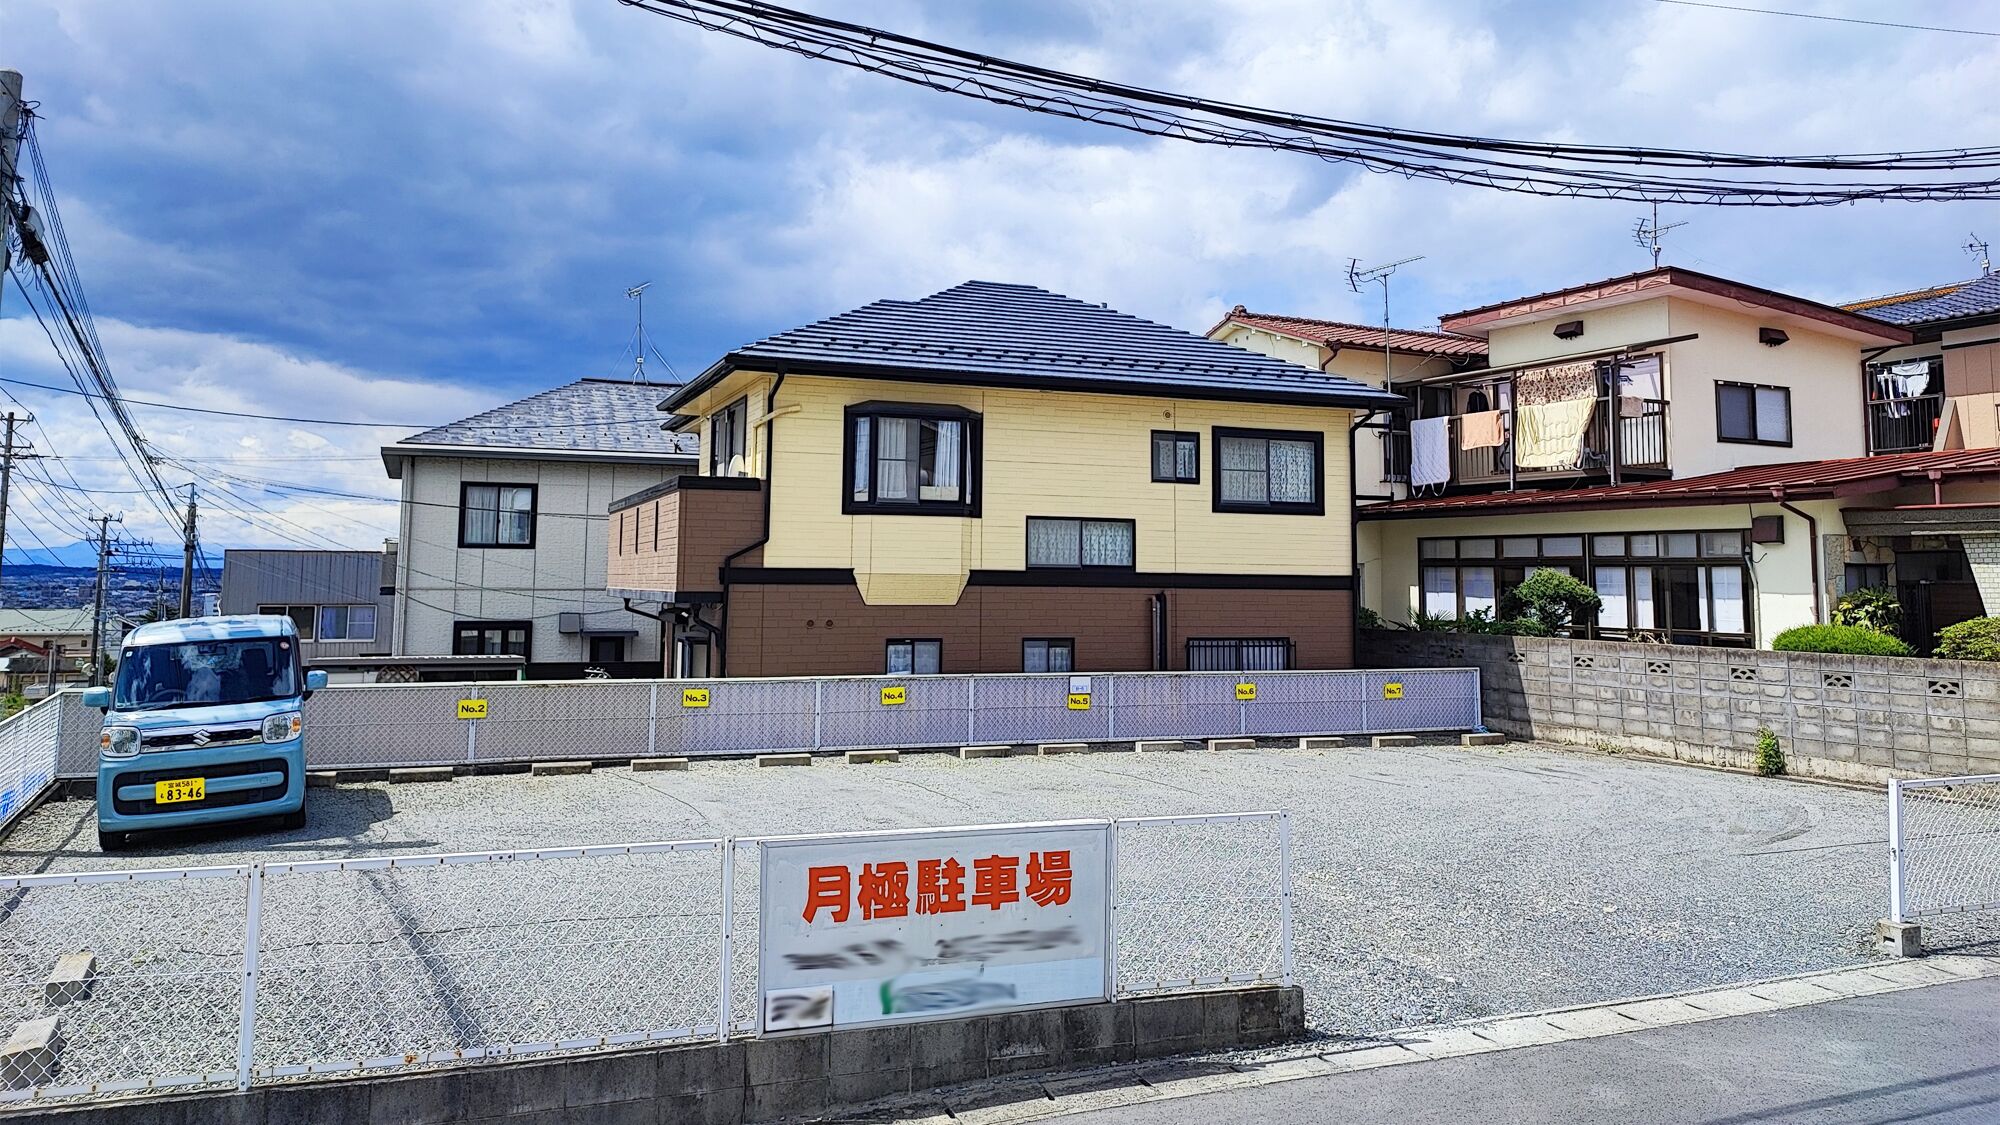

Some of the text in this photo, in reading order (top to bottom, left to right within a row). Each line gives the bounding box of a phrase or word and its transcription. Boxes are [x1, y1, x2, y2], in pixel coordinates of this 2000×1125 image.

[1237, 687, 1255, 695] No.6
[1386, 687, 1401, 695] No.7
[685, 694, 707, 702] No.3
[884, 691, 903, 700] No.4
[1070, 697, 1089, 705] No.5
[461, 704, 485, 713] No.2
[166, 787, 202, 801] 83-46
[802, 850, 1073, 924] 月極駐車場
